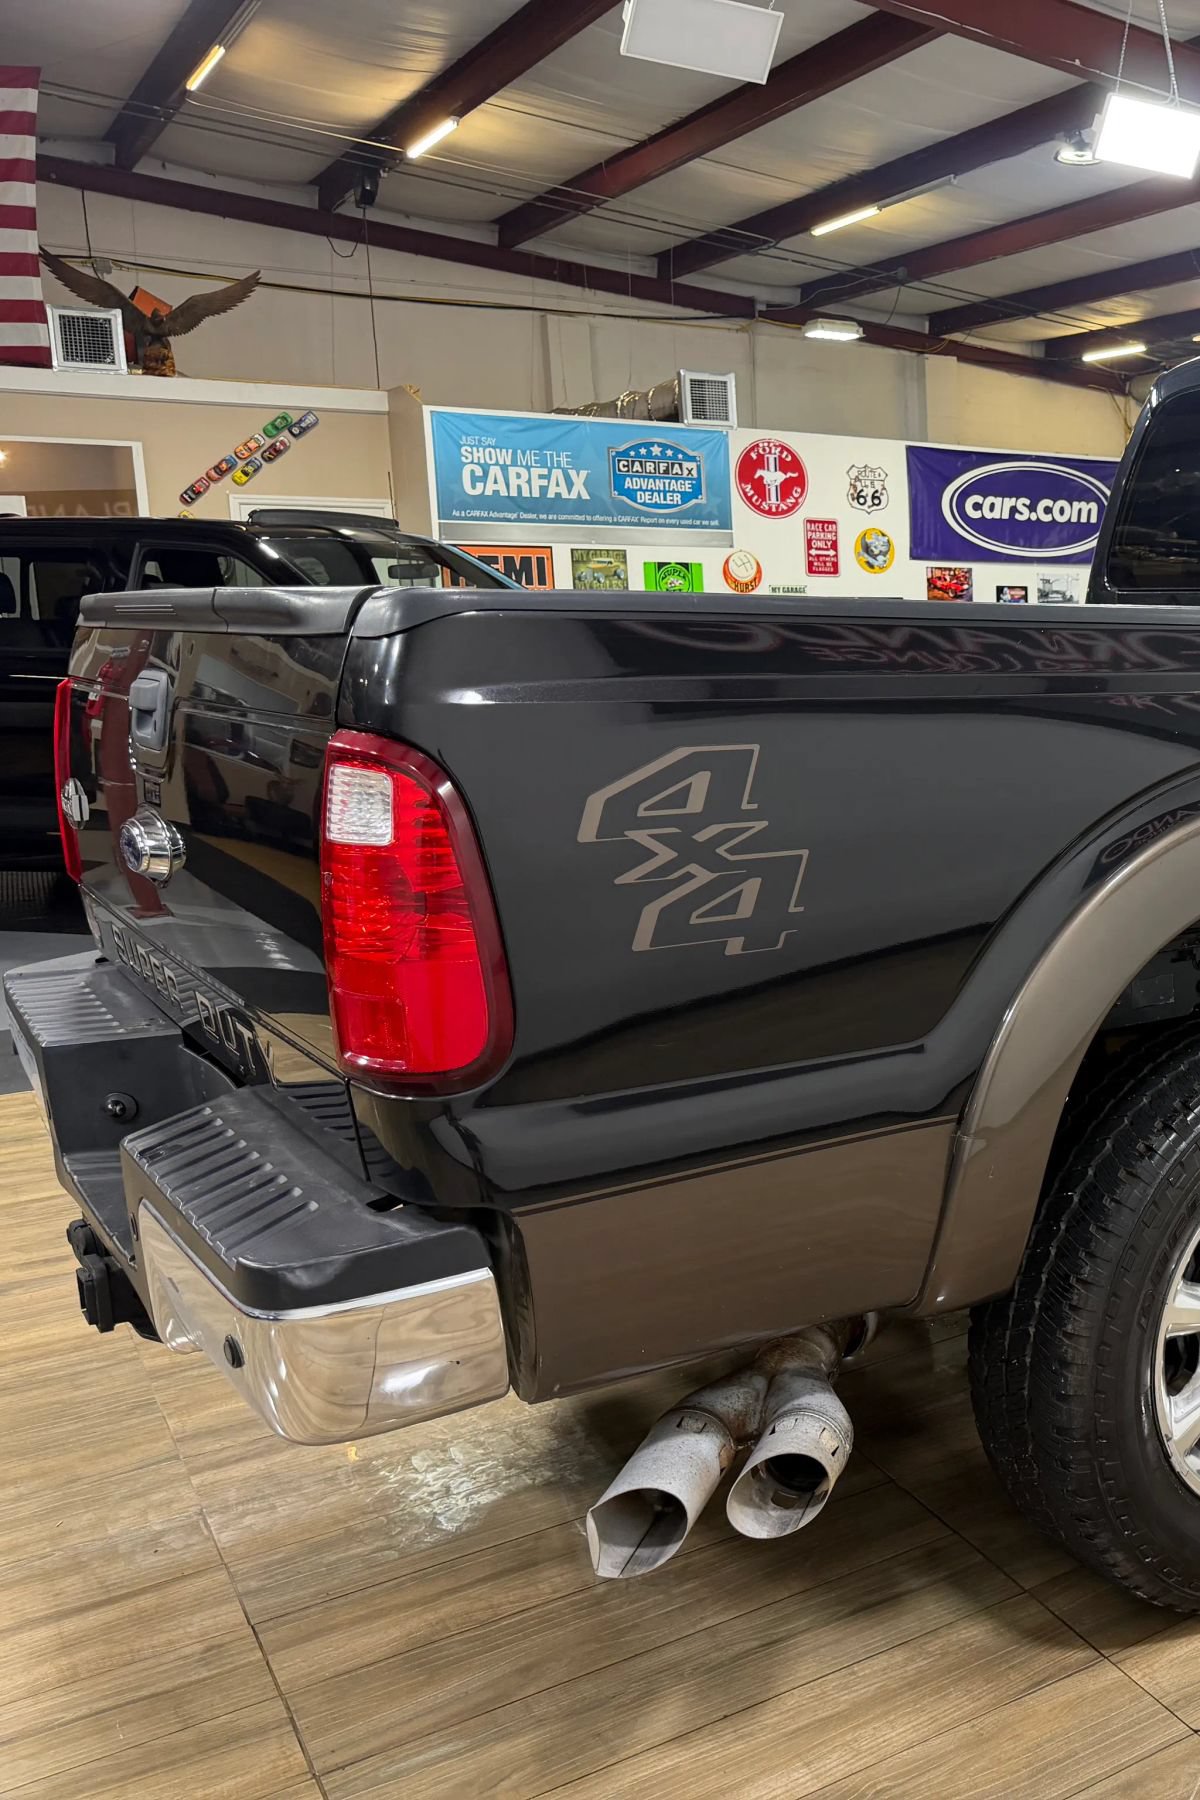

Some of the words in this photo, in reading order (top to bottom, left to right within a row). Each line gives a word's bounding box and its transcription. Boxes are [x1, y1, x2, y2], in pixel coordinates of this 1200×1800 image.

[459, 436, 479, 445] JUST
[480, 437, 496, 446] SAY
[460, 446, 512, 465] SHOW
[517, 449, 541, 466] ME
[543, 450, 573, 468] THE
[750, 446, 792, 462] FORD
[618, 460, 695, 477] CARFAX
[462, 463, 591, 500] CARFAX
[636, 491, 682, 505] DEALER
[741, 482, 802, 512] MUSTANG
[856, 488, 882, 507] 66
[964, 494, 1099, 524] cars.com
[452, 509, 460, 517] As
[466, 510, 489, 518] CARFAX
[558, 513, 585, 521] committed
[592, 515, 612, 523] offering
[641, 516, 658, 524] Report
[666, 518, 680, 526] every
[680, 517, 692, 525] used
[806, 522, 823, 532] RACE
[824, 523, 837, 532] CAR
[807, 531, 836, 541] PARKING
[811, 540, 833, 549] ONLY
[573, 550, 588, 561] MY
[734, 577, 757, 593] HURST
[111, 923, 185, 1013] SUPER
[195, 990, 278, 1089] DUTY
